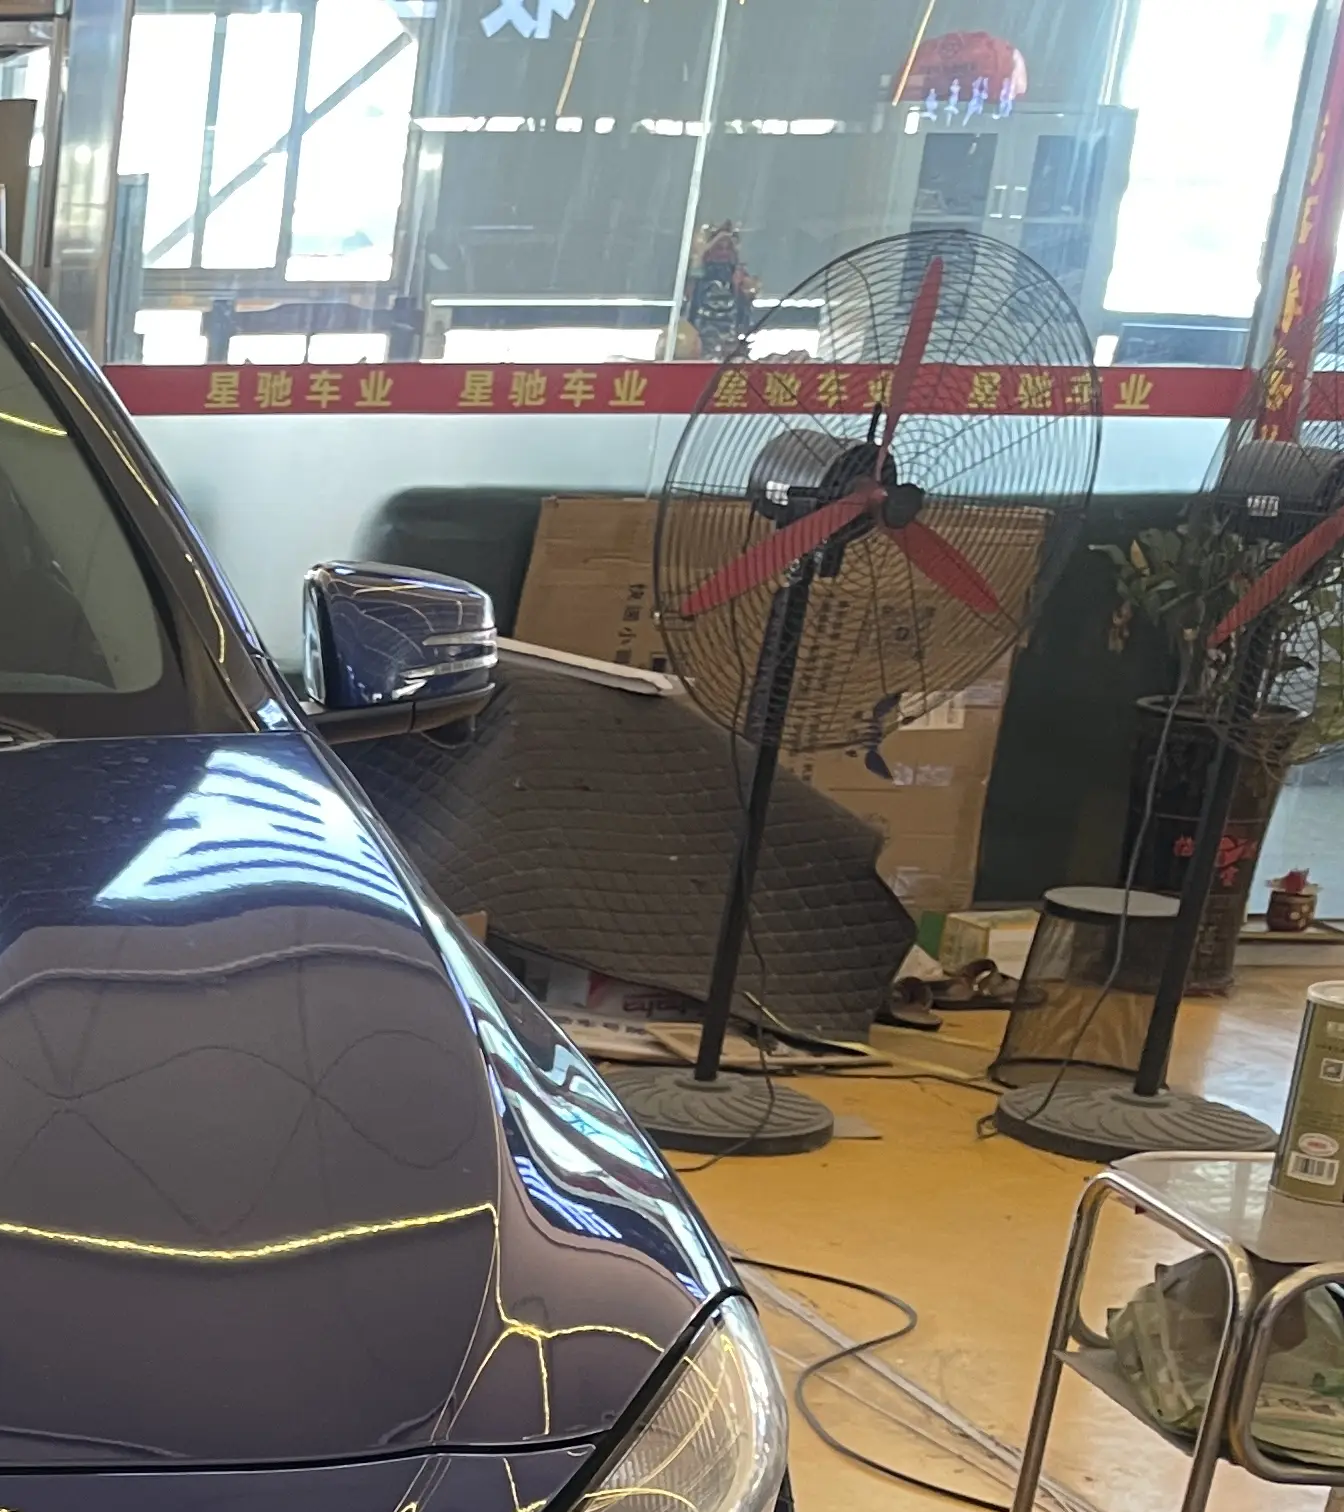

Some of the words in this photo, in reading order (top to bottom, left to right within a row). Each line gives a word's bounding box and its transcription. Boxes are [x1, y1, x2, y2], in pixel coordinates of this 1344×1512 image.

[203, 370, 394, 409] 星驰车业
[457, 370, 649, 409] 星驰车业
[966, 370, 1154, 411] 星驰车业
